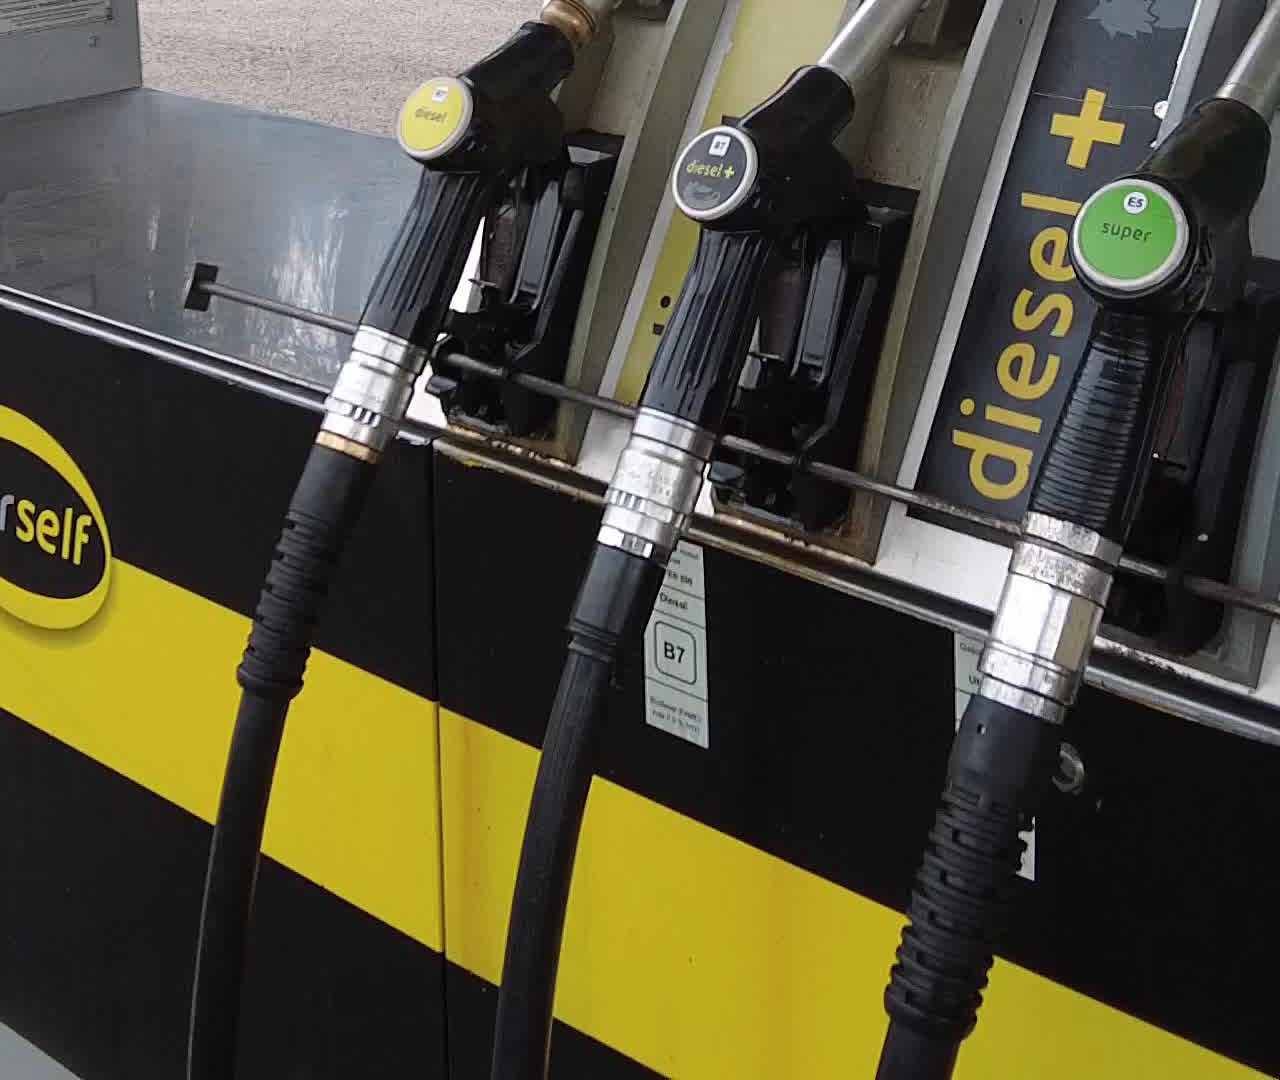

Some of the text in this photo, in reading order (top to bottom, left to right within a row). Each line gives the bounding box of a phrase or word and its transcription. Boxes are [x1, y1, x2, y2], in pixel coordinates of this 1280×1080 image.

[1127, 196, 1144, 208] E5
[1101, 222, 1152, 243] super
[952, 191, 1083, 502] diesel
[663, 640, 686, 664] B7
